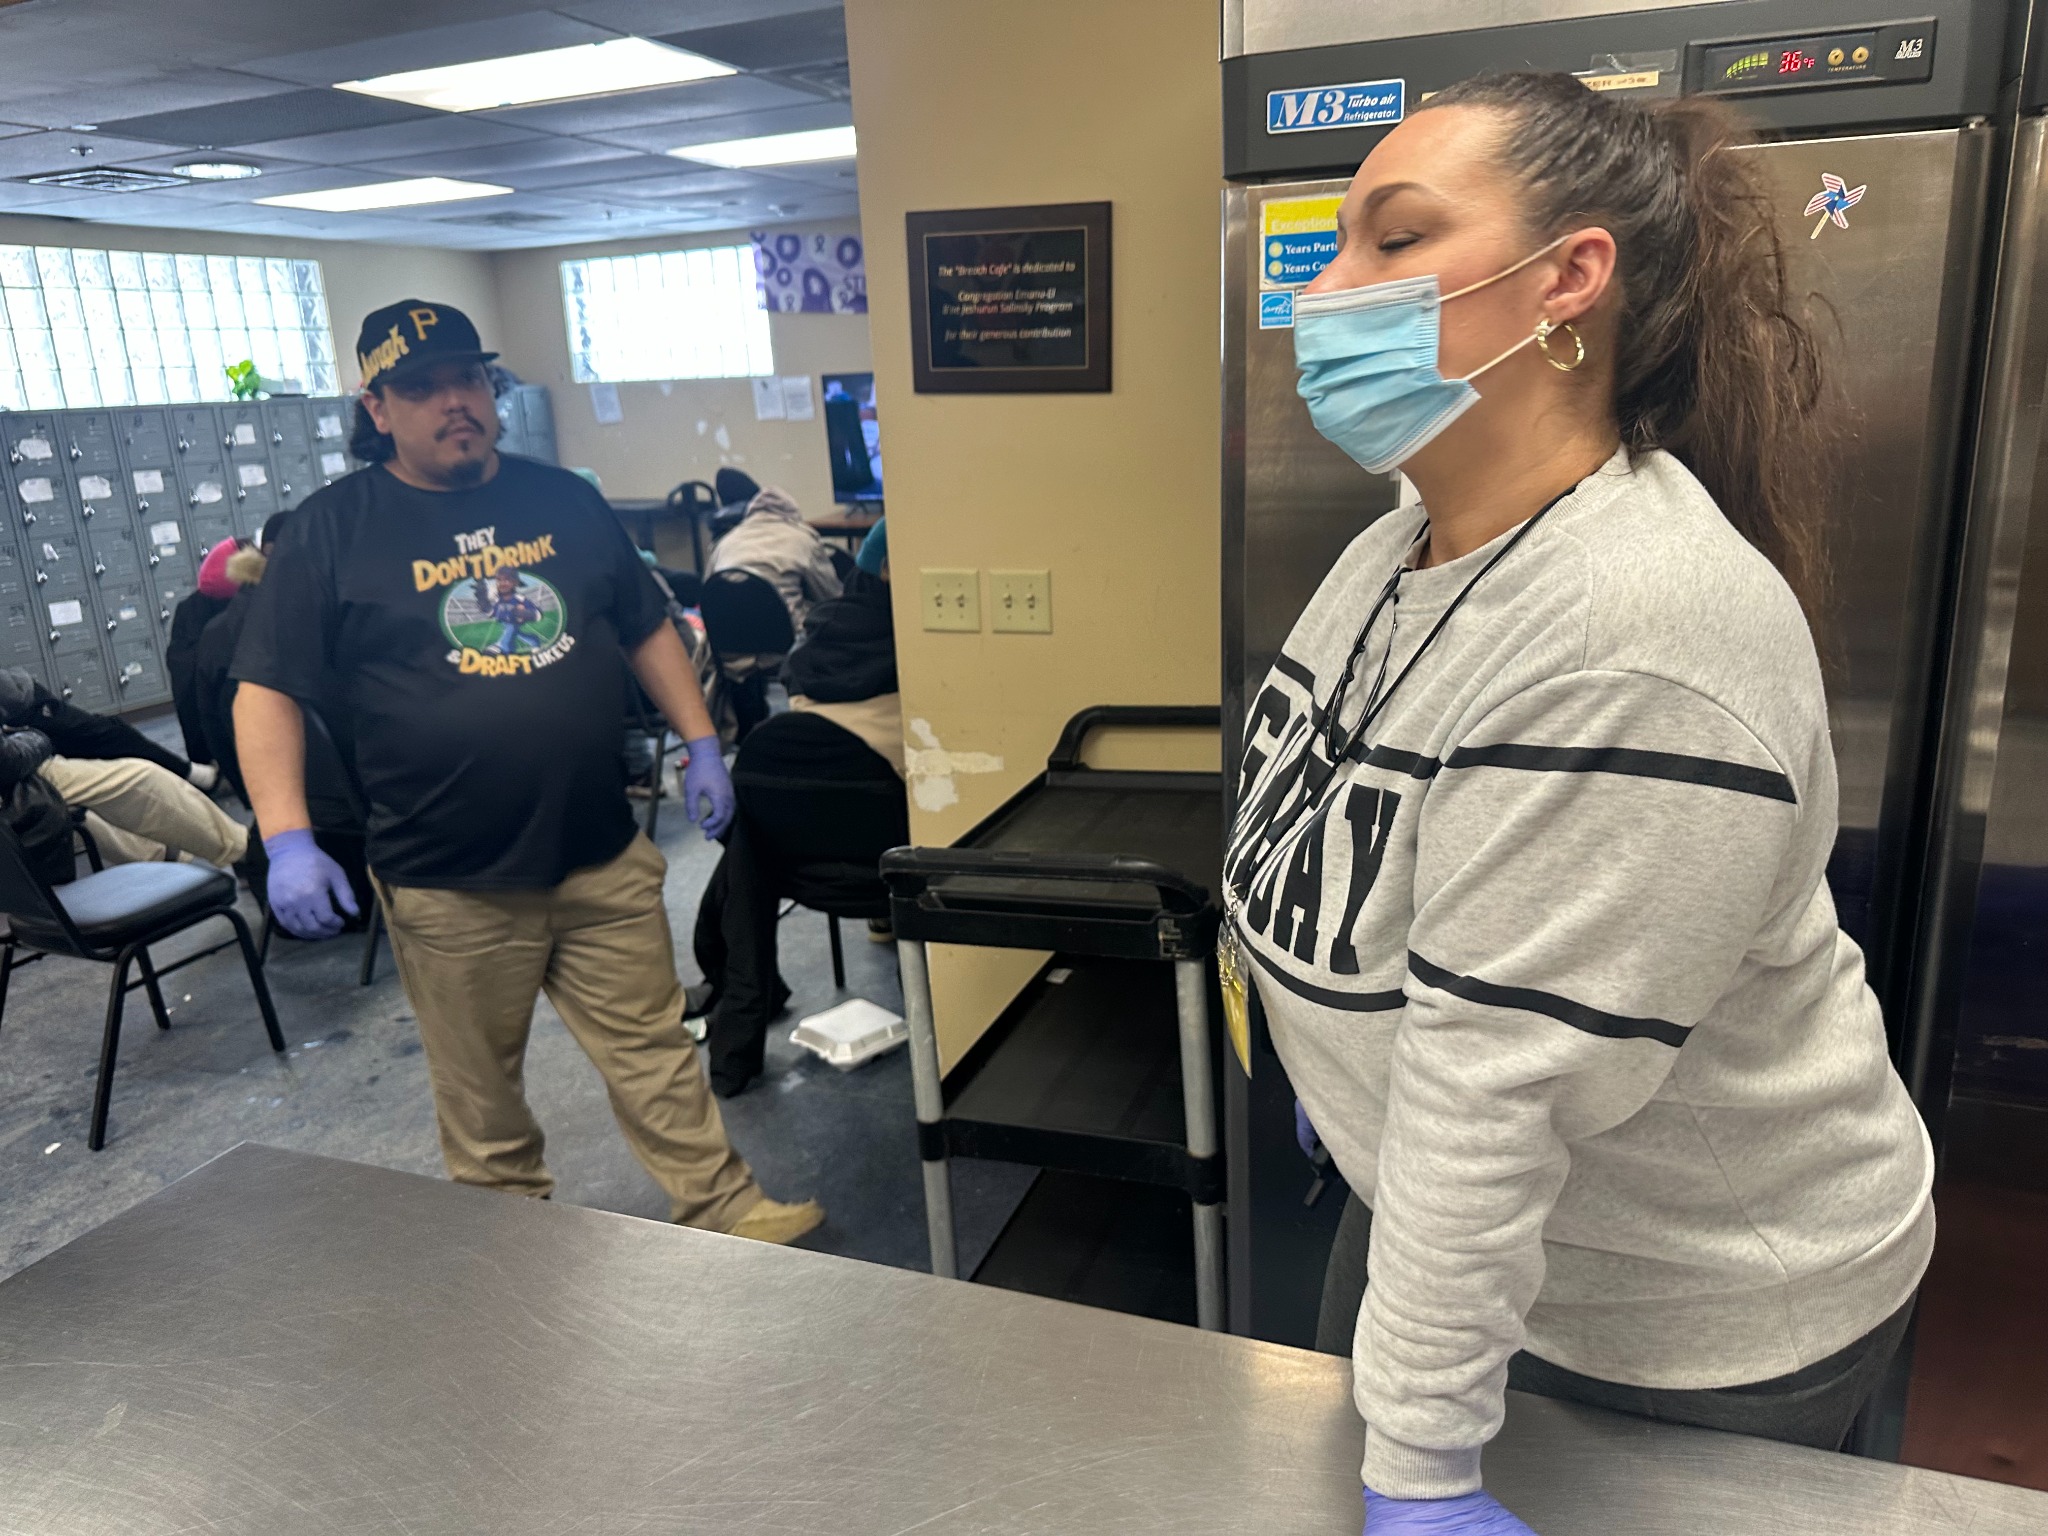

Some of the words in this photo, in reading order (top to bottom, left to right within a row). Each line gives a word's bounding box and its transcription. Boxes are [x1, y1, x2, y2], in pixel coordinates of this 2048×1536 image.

[1347, 95, 1377, 109] Turbo
[1379, 93, 1397, 106] air
[1272, 90, 1346, 128] M3
[1343, 110, 1396, 122] Refrigerator
[1285, 244, 1311, 255] Years
[1022, 261, 1065, 274] dedicated
[1065, 261, 1076, 272] to
[1284, 262, 1310, 274] Years
[958, 289, 1013, 303] Congregation
[1034, 302, 1073, 315] Program
[409, 308, 439, 340] P
[978, 329, 1018, 342] generous
[1019, 327, 1072, 339] contribution
[454, 526, 495, 554] THEY
[412, 554, 483, 592] DON'T
[482, 534, 557, 577] DRINK
[459, 647, 532, 677] DRAFT
